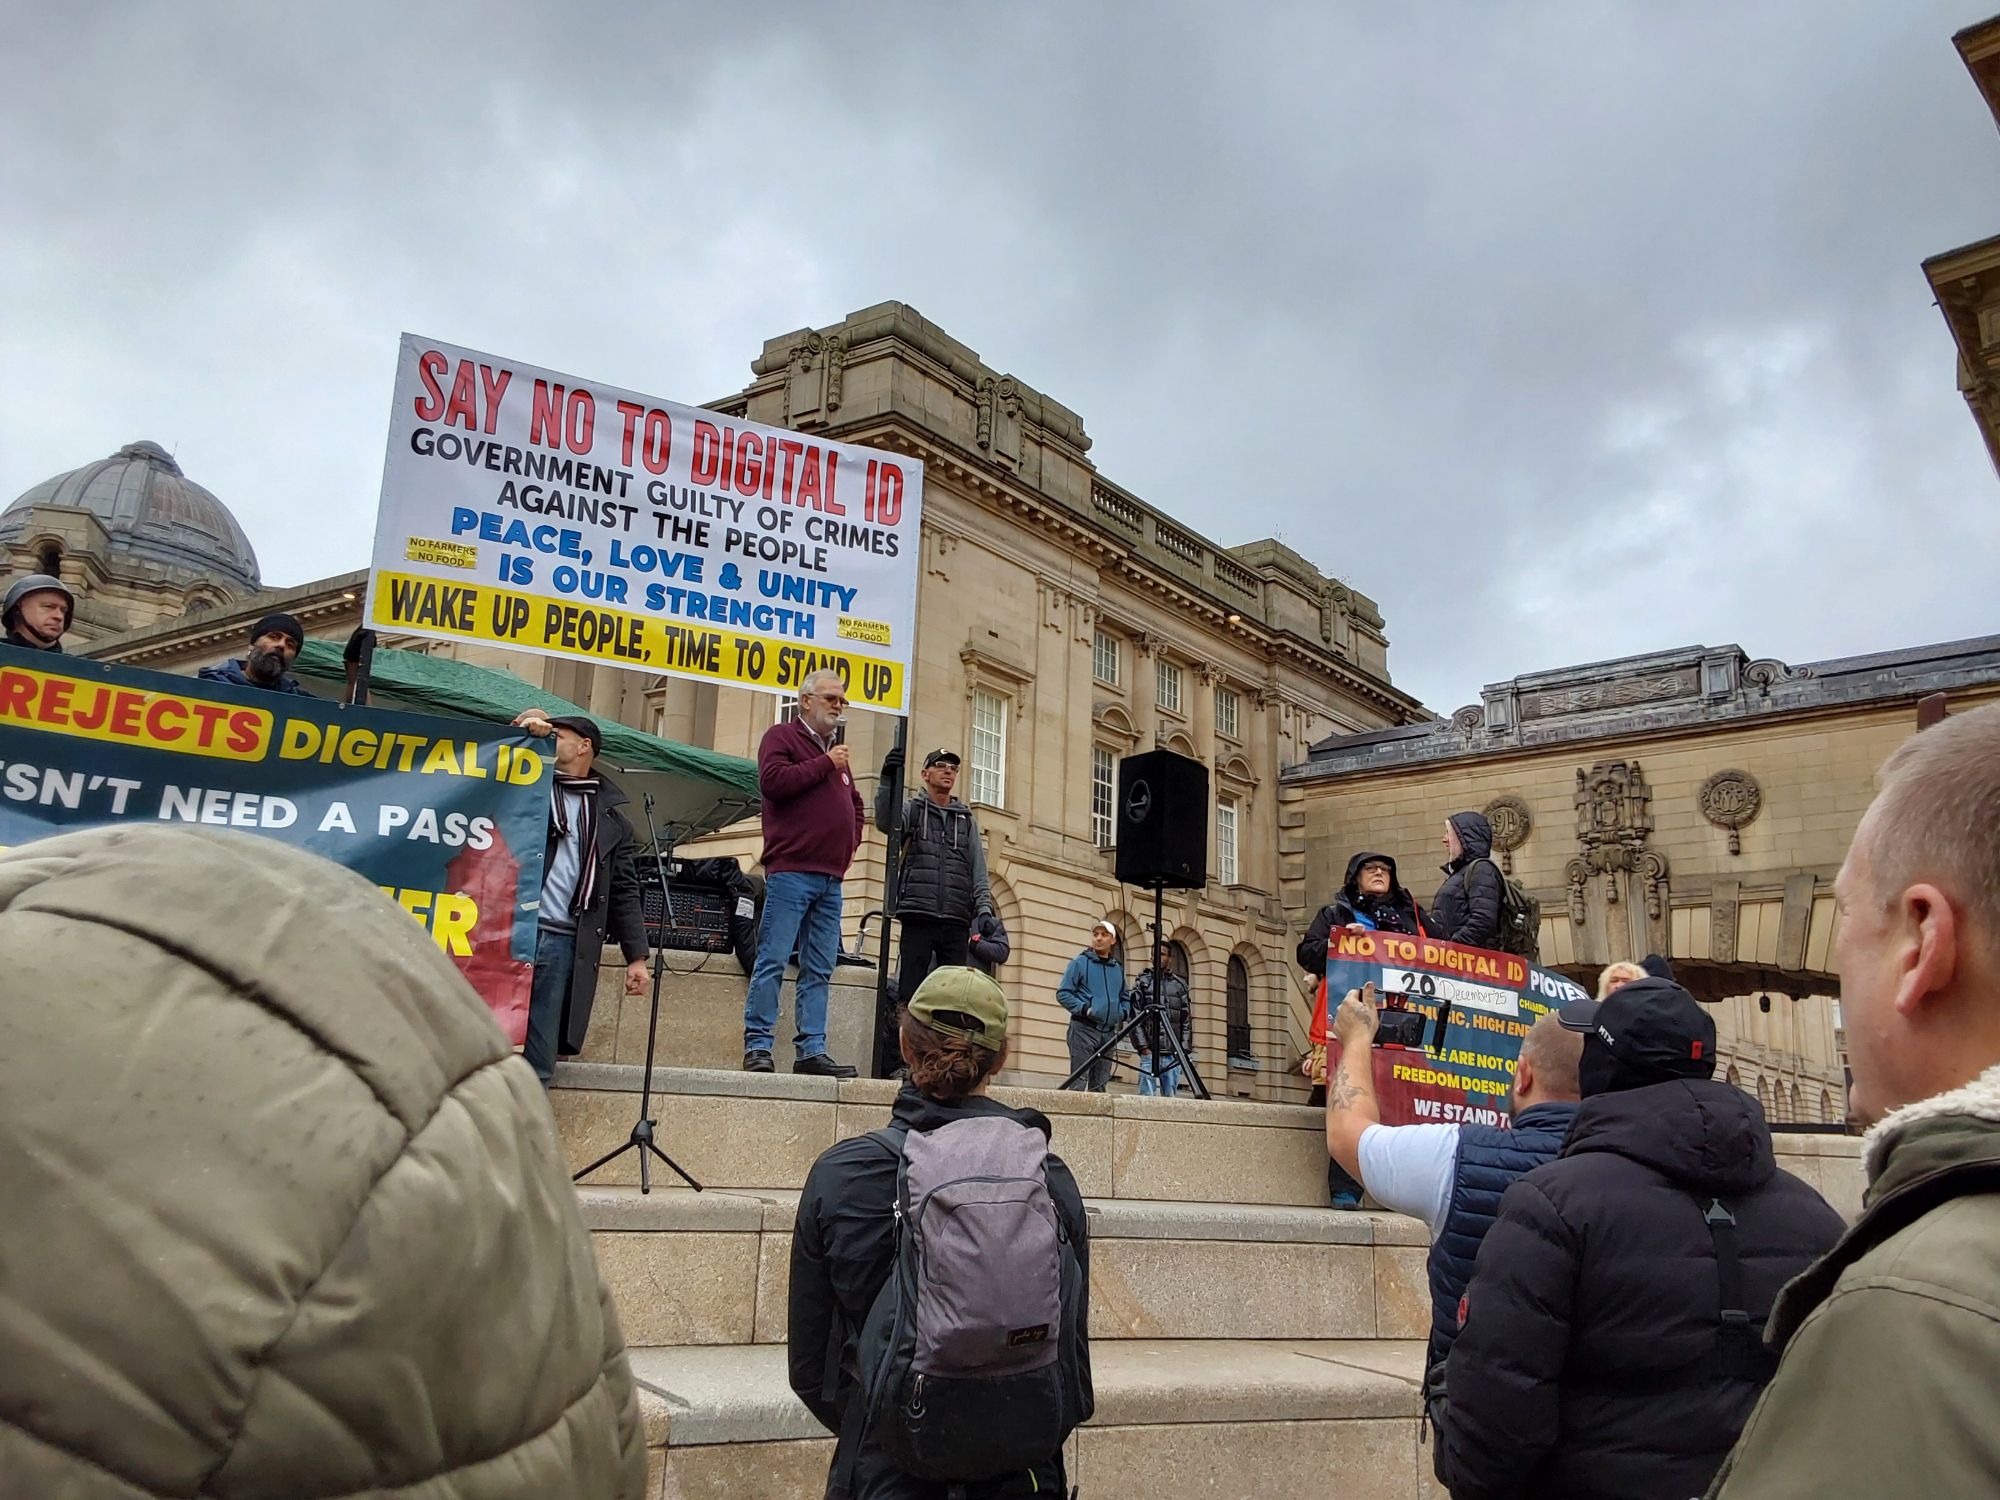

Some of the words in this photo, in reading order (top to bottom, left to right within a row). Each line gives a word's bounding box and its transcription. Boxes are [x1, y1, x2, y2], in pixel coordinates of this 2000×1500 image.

[414, 350, 512, 435] SAY
[530, 378, 595, 456] NO
[617, 399, 672, 475] TO
[691, 418, 846, 517] DIGITAL
[865, 458, 904, 527] ID
[411, 427, 634, 497] GOVERNMENT
[647, 480, 745, 523] GUILTY
[757, 506, 792, 535] OF
[805, 516, 899, 558] CRIMES
[410, 538, 426, 547] NO
[429, 540, 476, 556] FARMERS
[497, 480, 638, 533] AGAINST
[652, 512, 711, 549] THE
[725, 528, 828, 573] PEOPLE
[418, 552, 434, 562] NO
[436, 555, 465, 567] FOOD
[451, 506, 593, 566] PEACE,
[610, 538, 704, 584] LOVE
[718, 563, 743, 592] &
[758, 570, 858, 613] UNITY
[499, 553, 534, 586] IS
[552, 564, 628, 605] OUR
[645, 582, 816, 640] STRENGTH
[390, 578, 475, 633] WAKE
[492, 596, 530, 639] UP
[544, 604, 651, 665] PEOPLE,
[664, 626, 720, 673] TIME
[735, 638, 766, 681] TO
[863, 662, 892, 701] UP
[839, 618, 852, 626] NO
[853, 620, 890, 632] FARMERS
[846, 630, 858, 638] NO
[860, 632, 883, 642] FOOD
[0, 671, 263, 753] REJECTS
[279, 719, 487, 779] DIGITAL
[495, 745, 544, 786] ID
[0, 761, 141, 815] SN'T
[158, 784, 298, 829] NEED
[317, 801, 357, 834] A
[378, 805, 494, 850] PASS
[1338, 935, 1376, 957] NO
[1384, 938, 1417, 961] TO
[1424, 945, 1500, 978] DIGITAL
[1507, 961, 1524, 983] ID
[1473, 1014, 1505, 1034] HIGH
[1393, 1065, 1460, 1089] FREEDOM
[1448, 1049, 1475, 1066] ARE
[1477, 1054, 1503, 1072] NOT
[1414, 1098, 1442, 1119] WE
[1443, 1102, 1498, 1126] STAND
